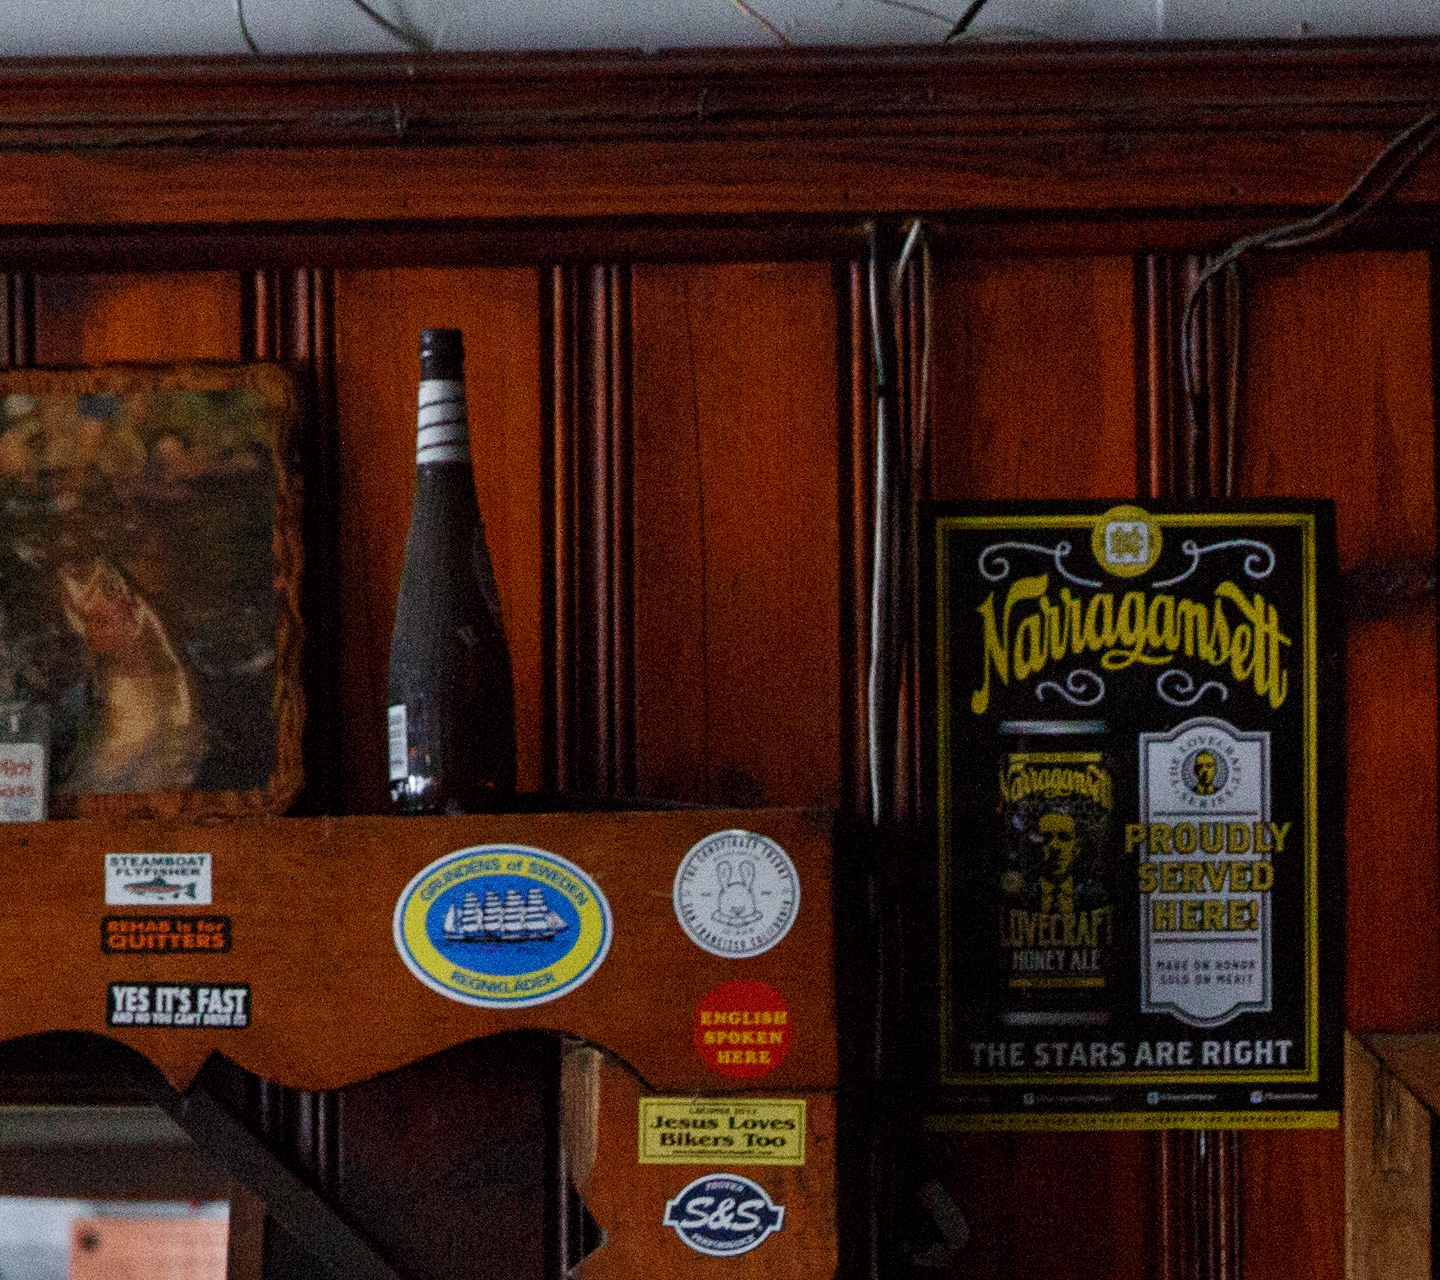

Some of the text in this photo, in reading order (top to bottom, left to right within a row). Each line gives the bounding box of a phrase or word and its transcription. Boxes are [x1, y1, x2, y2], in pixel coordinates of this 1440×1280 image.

[970, 572, 1293, 716] Narragansett
[1124, 821, 1292, 855] PROUDLY
[110, 855, 207, 867] STEAMBOAT
[115, 867, 201, 877] FLYFISHER
[1137, 861, 1275, 894] SERVED
[1152, 900, 1260, 932] HERE!
[106, 933, 226, 950] QUITTERS
[112, 984, 248, 1014] YES IT'S FAST
[699, 1010, 789, 1027] ENGLISH
[703, 1030, 784, 1046] SPOKEN
[716, 1050, 772, 1066] HERE
[969, 1039, 1295, 1068] THE STARS ARE RIGHT
[649, 1116, 796, 1131] Jesus Loves
[659, 1132, 787, 1148] Bikers Too
[679, 1196, 766, 1232] S&S
